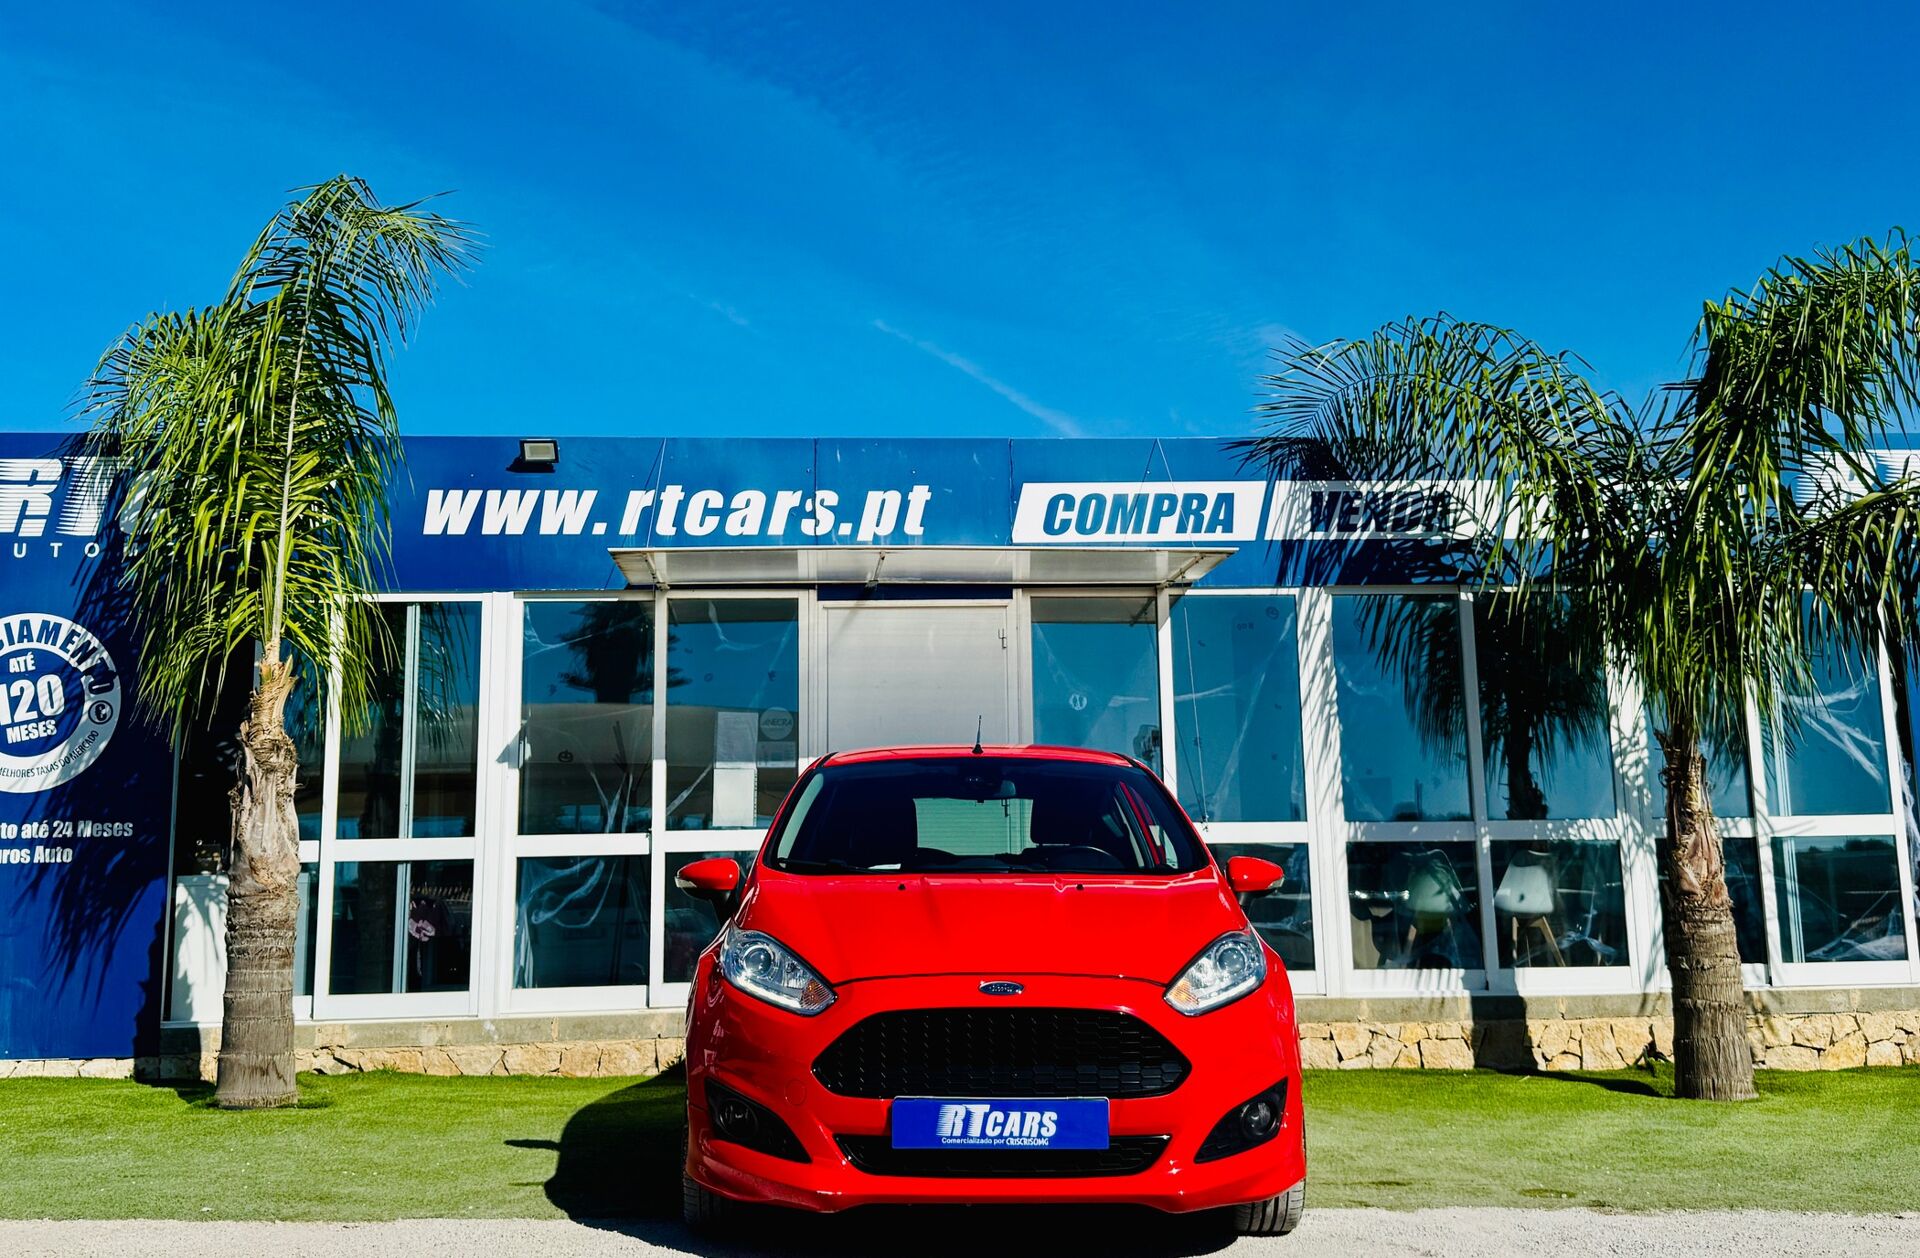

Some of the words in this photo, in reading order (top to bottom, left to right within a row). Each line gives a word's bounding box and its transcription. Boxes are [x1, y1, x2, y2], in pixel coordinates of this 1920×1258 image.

[422, 484, 932, 542] www.rtcars.pt
[1042, 492, 1236, 536] COMPRA
[1310, 490, 1452, 533] VENDA
[0, 619, 115, 696] IAMENTO
[9, 652, 36, 673] ATÉ
[6, 719, 57, 744] MESES
[36, 761, 59, 776] TAXAS
[59, 755, 71, 768] DO
[69, 730, 100, 760] MERCADO
[21, 820, 49, 839] até
[52, 820, 73, 838] 24
[77, 820, 134, 838] Meses
[33, 845, 73, 863] Auto
[993, 1138, 1005, 1146] por
